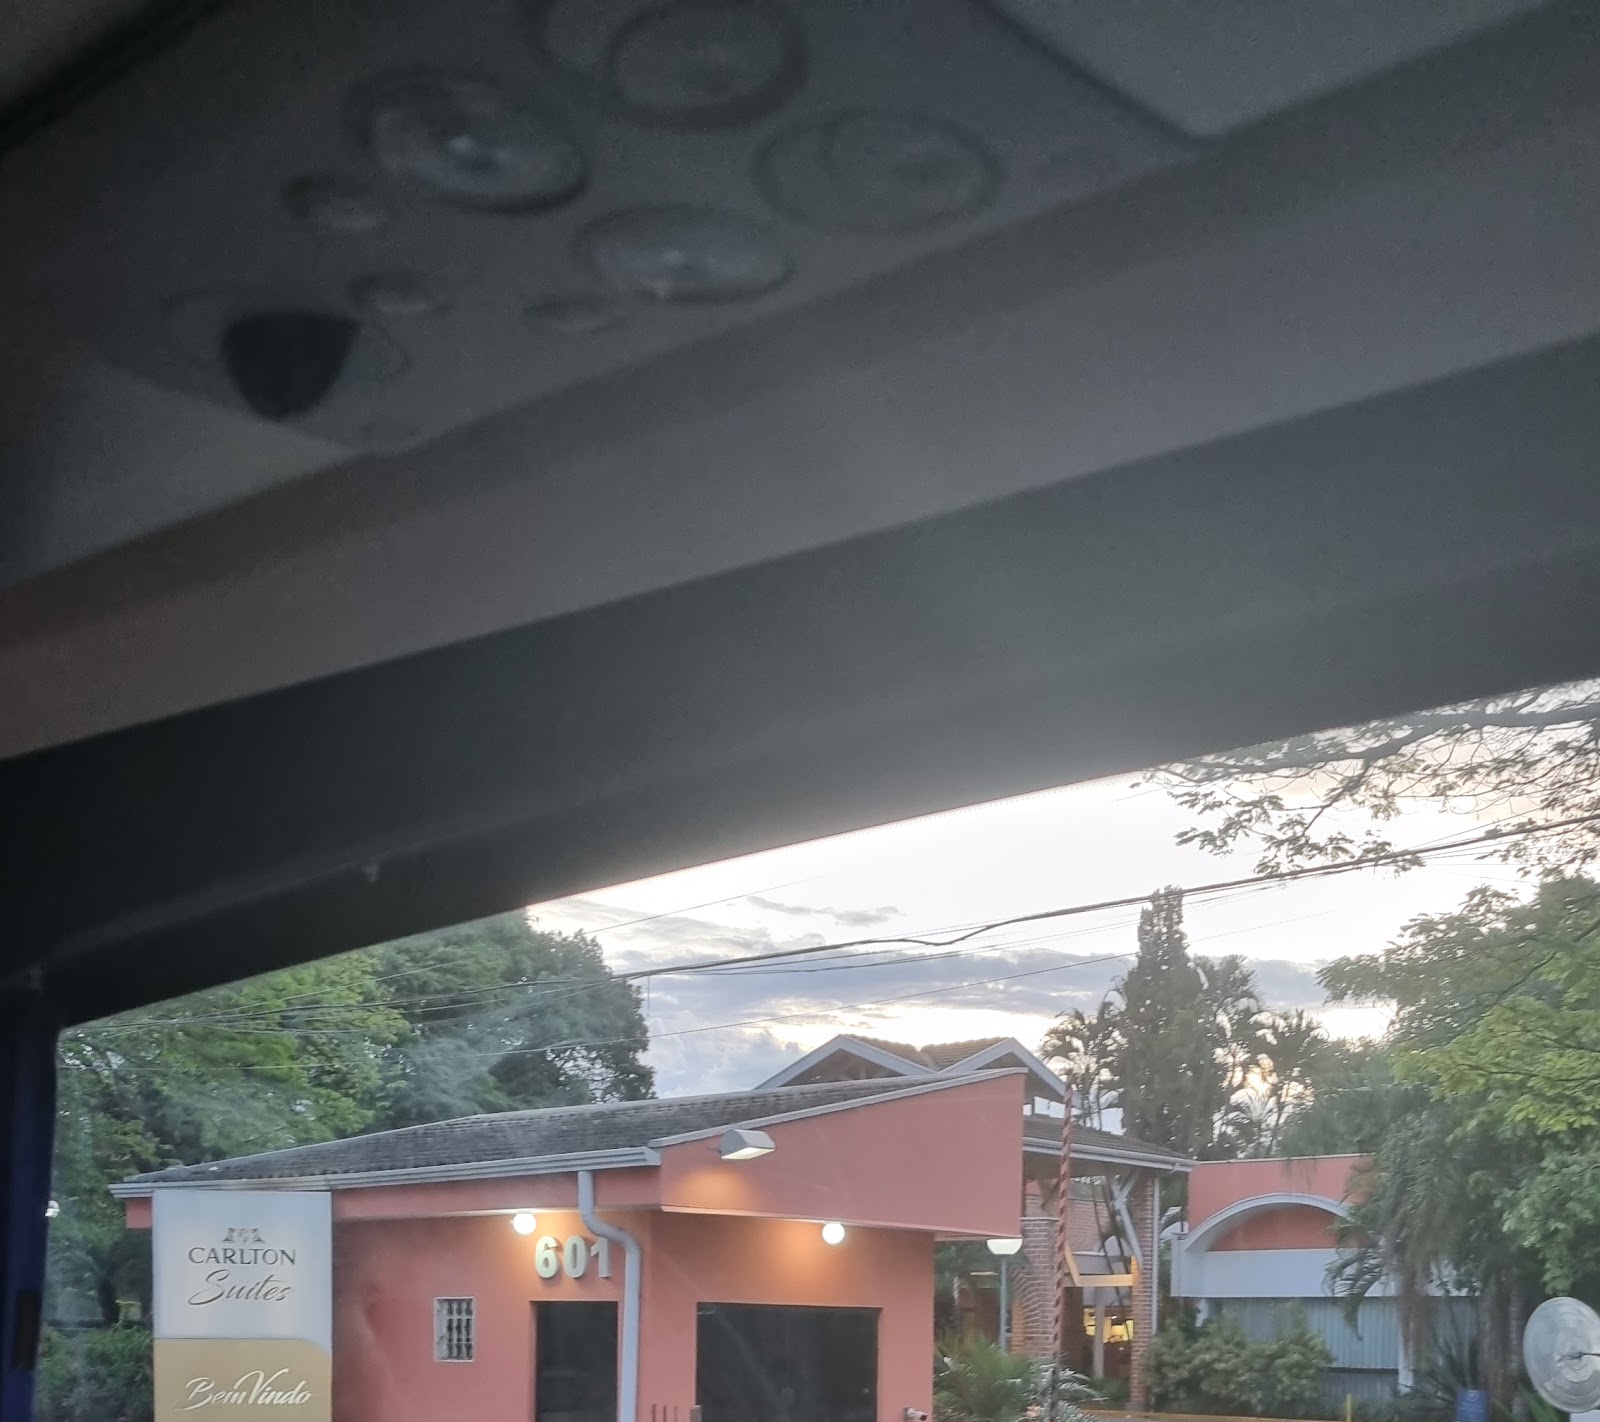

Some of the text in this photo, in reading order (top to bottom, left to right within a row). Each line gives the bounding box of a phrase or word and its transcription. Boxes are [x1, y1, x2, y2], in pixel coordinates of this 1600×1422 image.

[188, 1246, 296, 1265] CARLTON
[534, 1235, 612, 1279] 601
[187, 1269, 295, 1305] Suites
